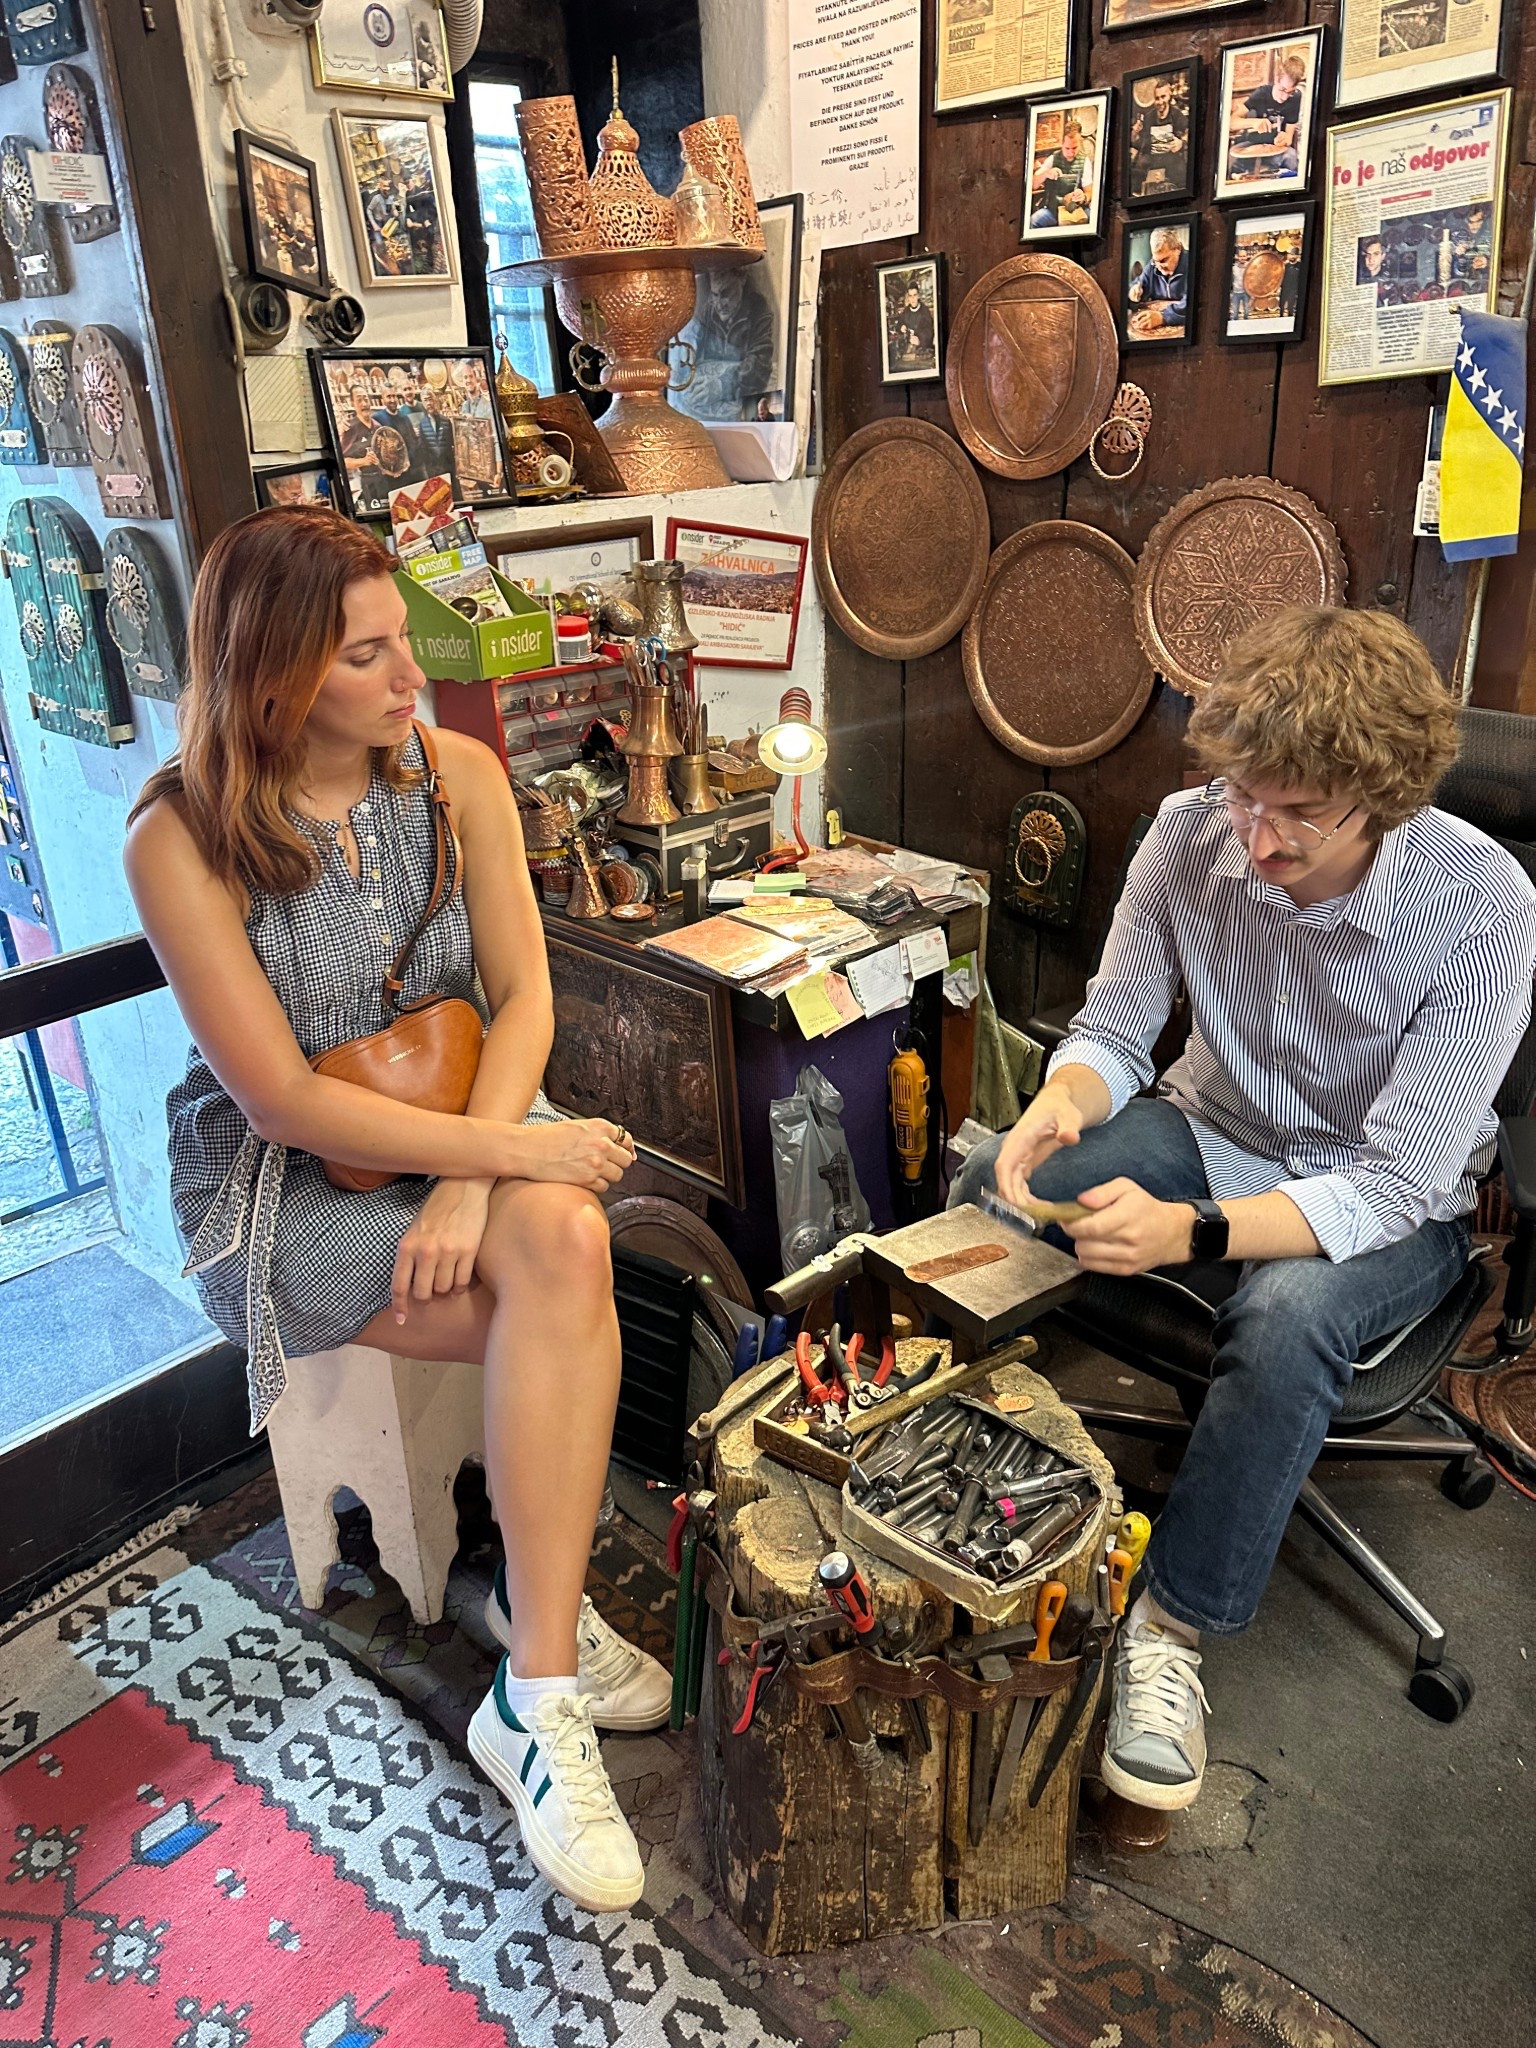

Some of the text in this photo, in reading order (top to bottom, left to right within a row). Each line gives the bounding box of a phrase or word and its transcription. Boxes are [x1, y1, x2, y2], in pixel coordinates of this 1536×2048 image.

[818, 13, 837, 24] HVALA
[838, 9, 847, 18] NA
[793, 40, 814, 51] PRICES
[815, 36, 827, 45] ARE
[828, 31, 844, 42] FIXED
[845, 27, 857, 37] AND
[858, 20, 880, 33] POSTED
[880, 17, 889, 26] ON
[841, 38, 860, 48] THANK
[821, 73, 844, 85] YOKTUR
[821, 90, 894, 114] DIE PREISE SIND FEST UND
[809, 116, 838, 128] BEFINDEN
[839, 112, 852, 122] SICH
[854, 109, 865, 117] AUF
[866, 106, 878, 115] DEM
[839, 122, 858, 132] DANKE
[832, 143, 852, 153] PREZZI
[853, 140, 868, 149] SONO
[869, 136, 883, 145] FISSI
[821, 153, 856, 166] PROMINENTI
[857, 151, 866, 159] SUI
[848, 161, 869, 171] GRAZIE
[1357, 160, 1375, 186] je
[1381, 152, 1406, 177] naš
[1410, 141, 1490, 172] odgovor
[462, 547, 482, 558] FREE
[416, 555, 453, 576] insider
[463, 556, 482, 566] MAP
[701, 552, 775, 574] ZAHVALNICA
